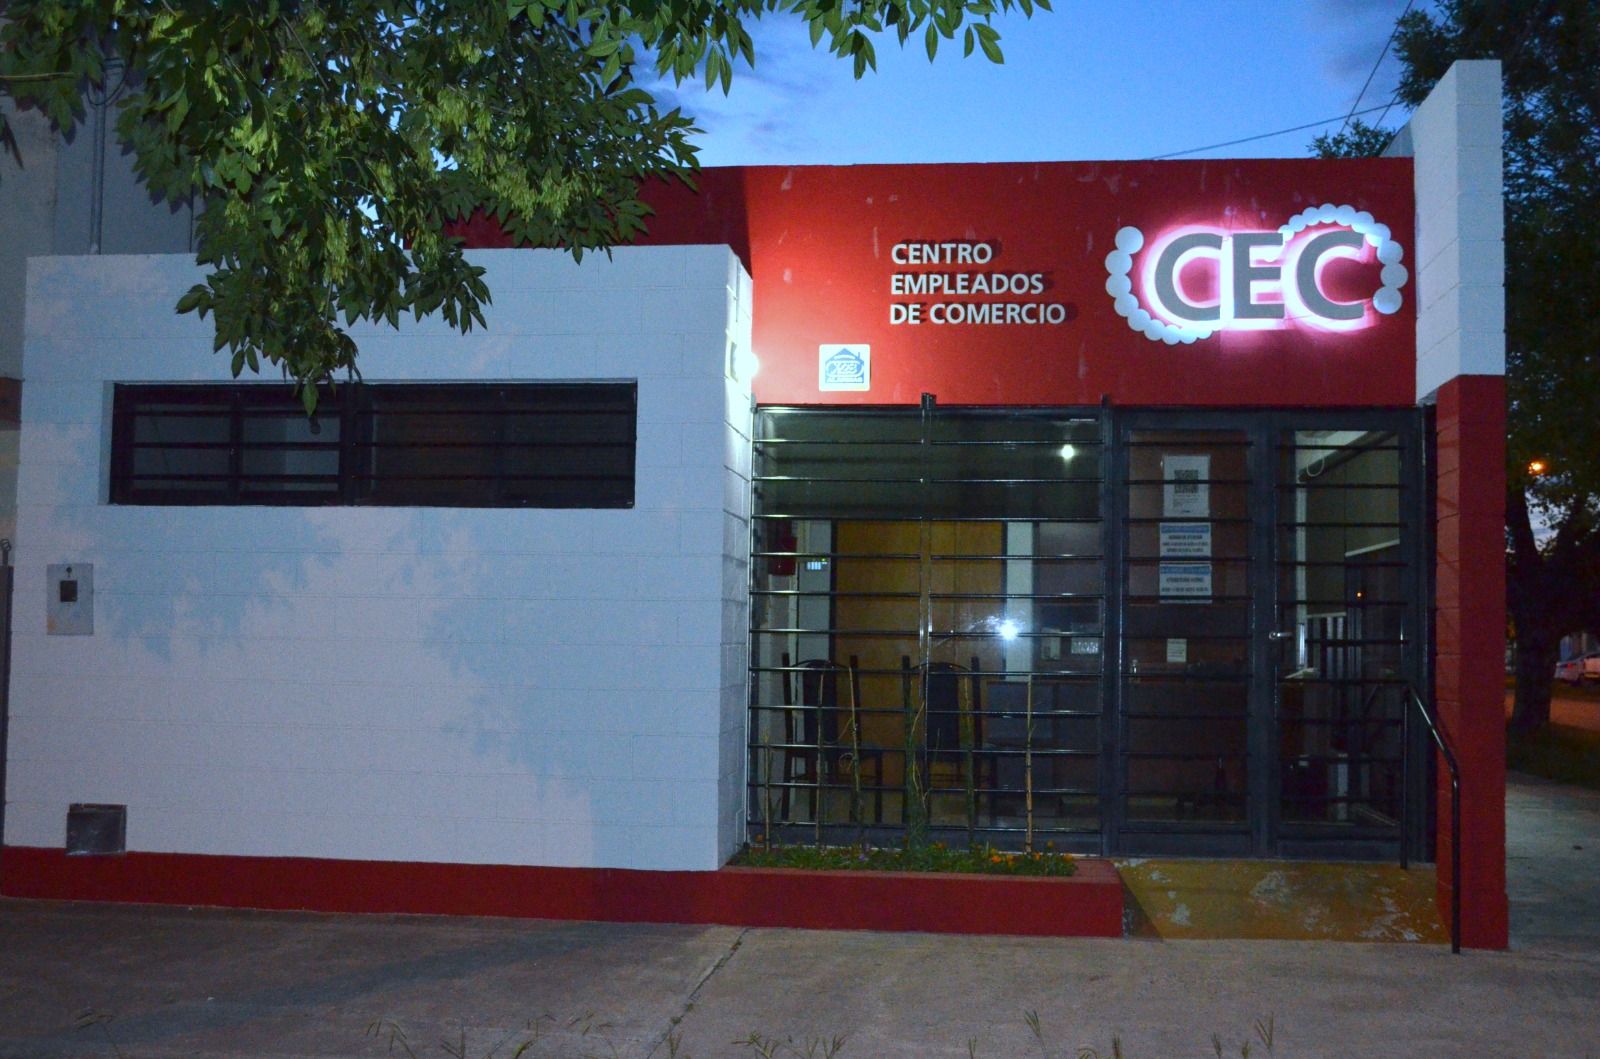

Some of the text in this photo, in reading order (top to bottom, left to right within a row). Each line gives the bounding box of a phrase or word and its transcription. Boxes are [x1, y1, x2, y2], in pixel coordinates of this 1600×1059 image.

[891, 243, 993, 265] CENTRO
[890, 273, 1044, 295] EMPLEADOS
[1154, 232, 1365, 321] CEC
[890, 303, 1066, 325] DE COMERCIO
